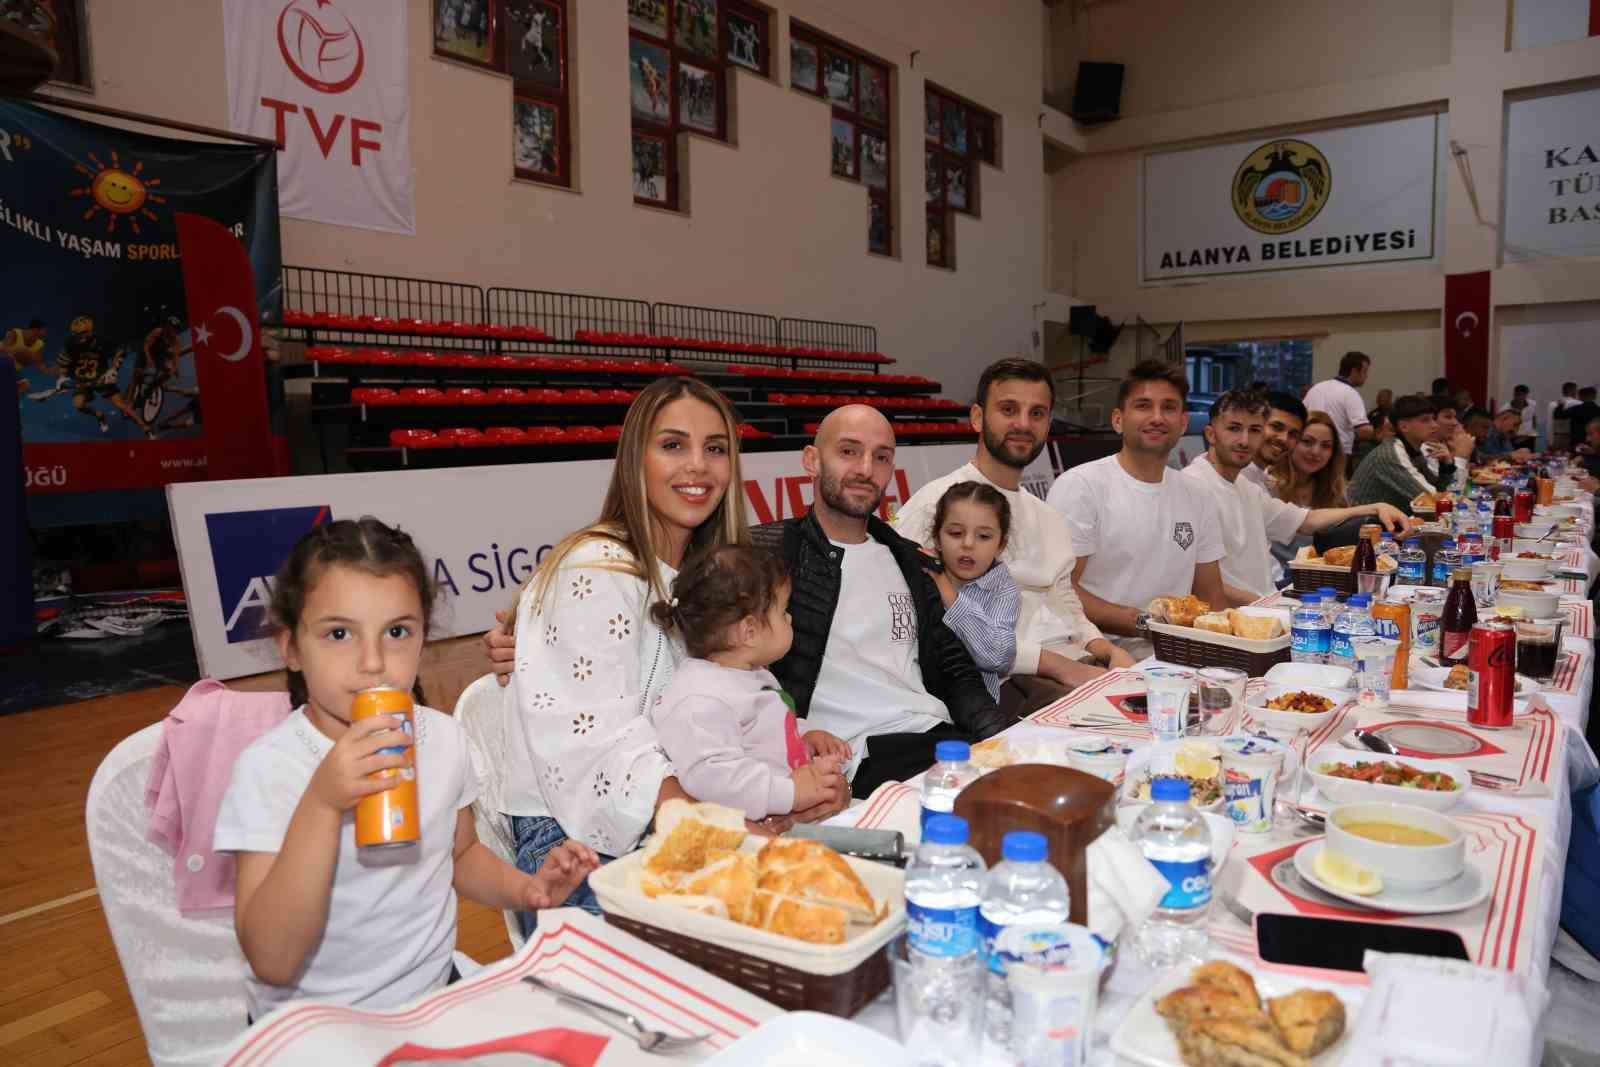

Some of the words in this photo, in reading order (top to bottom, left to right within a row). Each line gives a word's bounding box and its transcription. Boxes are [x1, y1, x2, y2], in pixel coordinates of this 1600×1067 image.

[260, 96, 383, 167] TVF
[56, 228, 121, 259] YAŞAM
[1160, 245, 1251, 270] ALANYA
